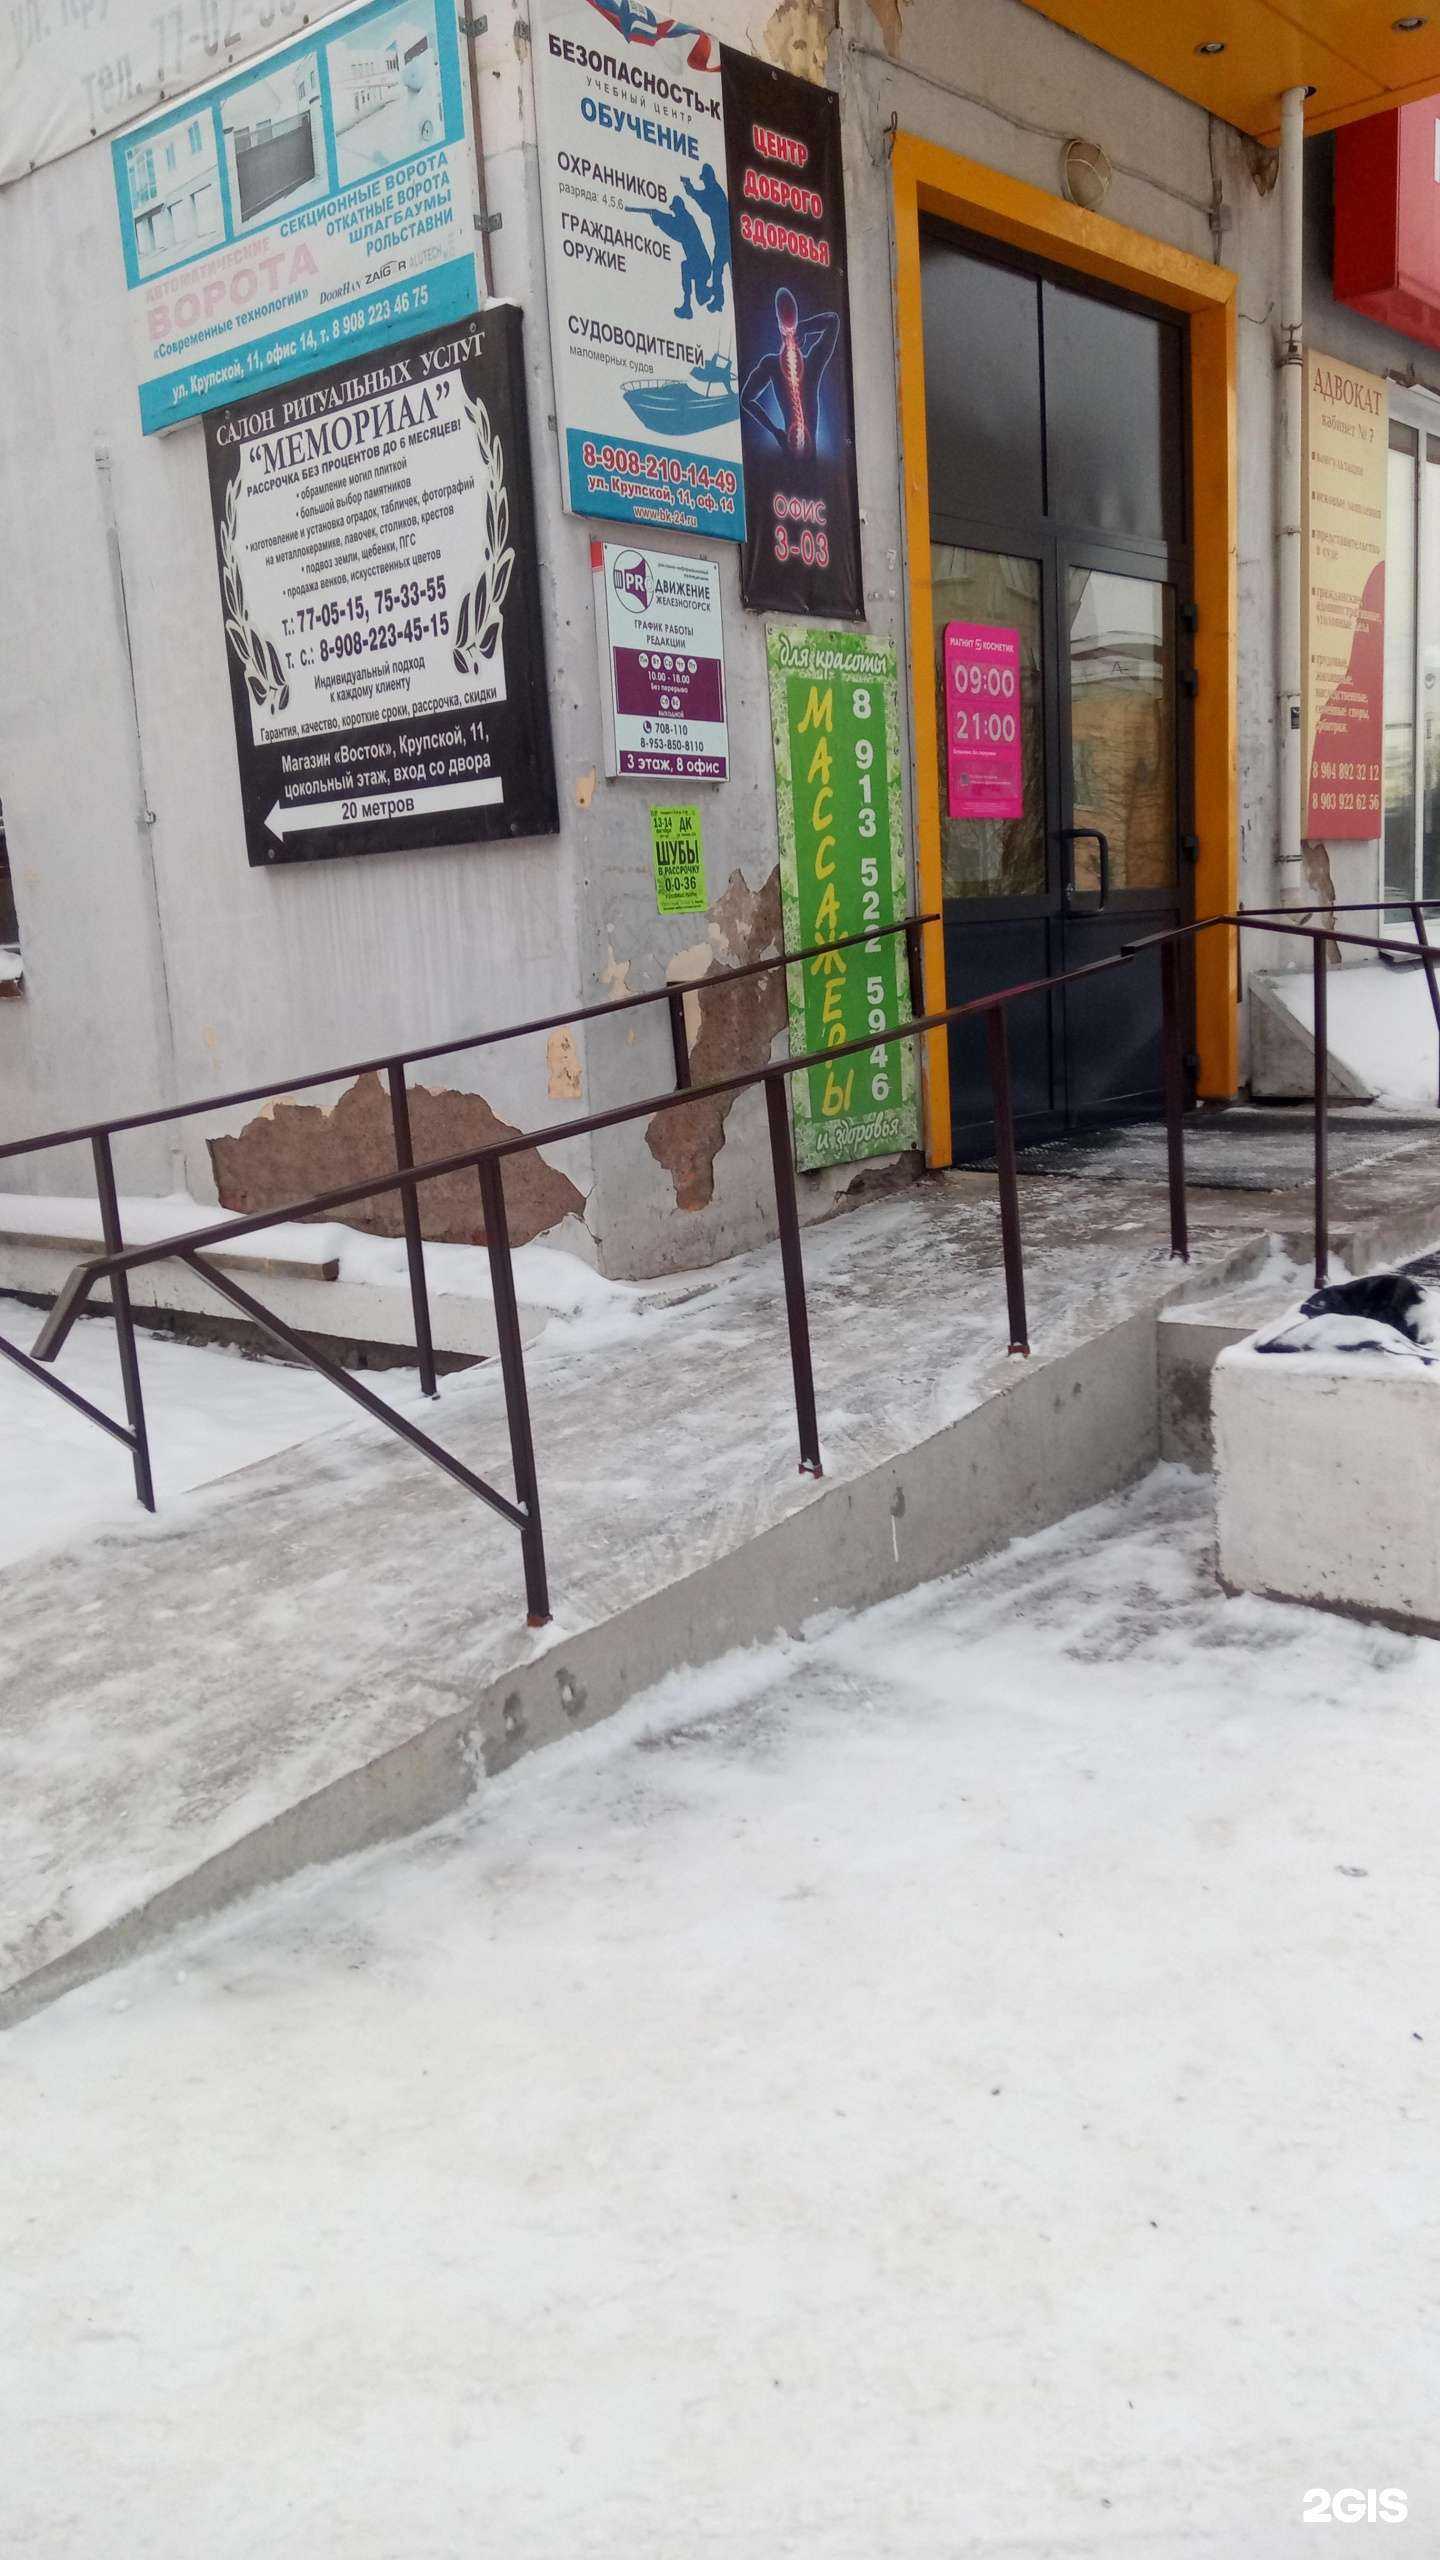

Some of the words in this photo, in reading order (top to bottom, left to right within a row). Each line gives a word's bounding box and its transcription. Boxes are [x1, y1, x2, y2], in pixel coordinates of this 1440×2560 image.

[548, 33, 721, 121] БЕЗОПАСНОСТЬ-К
[586, 75, 647, 108] УЧЕБНЫЙ
[654, 102, 693, 124] ЦЕНТР
[580, 96, 699, 161] ОБУЧЕНИЕ
[753, 125, 808, 167] ЦЕНТР
[280, 180, 381, 238] СЕКЦИОННЫЕ
[385, 151, 448, 192] ВОРОТА
[557, 151, 667, 203] ОХРАННИКОВ
[744, 169, 823, 218] ДОБРОГО
[326, 195, 394, 236] ОТКАТНЫЕ
[398, 171, 450, 205] ВОРОТА
[349, 189, 452, 244] ШЛАГБАУМЫ
[366, 207, 453, 257] РОЛЬСТАВНИ
[561, 212, 671, 261] ГРАЖДАНСКОЕ
[563, 239, 627, 273] ОРУЖИЕ
[741, 215, 830, 266] ЗДОРОВЬЯ
[148, 243, 319, 341] ВОРОТА
[153, 319, 233, 360] «Современные
[236, 288, 309, 327] технологии»
[173, 385, 188, 405] ул.
[191, 359, 244, 395] Крупской,
[247, 350, 263, 371] 11,
[266, 342, 297, 368] офис
[300, 330, 317, 351] 14,
[333, 319, 340, 339] 8
[343, 310, 365, 334] 908
[368, 300, 391, 324] 223
[394, 292, 410, 316] 46
[411, 285, 428, 306] 75
[568, 315, 705, 367] СУДОВОДИТЕЛЕЙ
[569, 345, 627, 367] маломерных
[629, 358, 654, 374] судов
[216, 407, 274, 447] САЛОН
[283, 360, 412, 424] РИТУАЛЬНЫХ
[420, 332, 485, 376] УСЛУГ
[1313, 368, 1382, 416] АДВОКАТ
[247, 472, 299, 497] РАССРОЧКА
[302, 467, 319, 481] БЕЗ
[322, 445, 380, 474] ПРОЦЕНТОВ
[383, 441, 397, 457] ДО
[400, 439, 406, 449] 6
[409, 419, 461, 447] МЕСЯЦЕВ!
[301, 477, 347, 500] обрамление
[349, 469, 372, 485] могил
[374, 458, 407, 478] плиткой
[583, 441, 736, 494] 8-908-210-14-49
[250, 528, 299, 552] изготовление
[306, 519, 345, 538] установка
[346, 508, 379, 527] оградок,
[381, 496, 420, 515] табличек,
[422, 475, 475, 505] фотографий
[300, 497, 334, 519] большой
[336, 493, 362, 510] выбор
[364, 478, 411, 501] памятников
[589, 474, 609, 491] ул.
[611, 479, 675, 503] Крупской,
[677, 489, 694, 507] 11,
[697, 495, 719, 512] оф.
[721, 497, 734, 512] 14
[633, 506, 698, 528] www.bk-24.ru
[773, 494, 827, 526] ОФИС
[265, 556, 275, 567] на
[275, 538, 343, 565] металлокерамике,
[344, 529, 378, 548] лавочек,
[379, 516, 420, 536] столиков,
[421, 505, 454, 525] крестов
[306, 559, 333, 574] подвоз
[334, 551, 360, 568] земли,
[362, 542, 398, 561] щебенки,
[399, 533, 416, 551] ПГС
[774, 526, 829, 567] 3-03
[286, 581, 319, 599] продажа
[320, 573, 349, 591] венков,
[350, 555, 411, 582] искусственных
[412, 549, 441, 568] цветов
[655, 578, 710, 600] ДВИЖЕНИЕ
[296, 595, 370, 633] 77-05-15,
[374, 574, 447, 615] 75-33-55
[656, 595, 711, 612] ЖЕЛЕЗНОГОРСК
[319, 611, 450, 662] 8-908-223-45-15
[634, 619, 663, 632] ГРАФИК
[665, 624, 694, 637] РАБОТЫ
[647, 634, 686, 649] РЕДАКЦИИ
[314, 660, 390, 690] Индивидуальный
[392, 656, 425, 680] подход
[779, 633, 809, 669] для
[814, 646, 888, 680] красоты
[336, 684, 373, 705] каждому
[375, 675, 411, 699] клиенту
[852, 688, 872, 720] 8
[954, 664, 1015, 698] 09:00
[260, 725, 299, 742] Гарантия,
[300, 717, 340, 736] качество,
[341, 710, 380, 731] короткие
[381, 705, 410, 724] сроки,
[412, 696, 462, 718] рассрочка,
[464, 687, 497, 706] скидки
[655, 723, 688, 736] 708-110
[955, 710, 1016, 742] 21:00
[282, 750, 331, 773] Магазин
[334, 741, 396, 767] «Восток»,
[399, 726, 467, 755] Крупской,
[470, 721, 489, 745] 11,
[627, 753, 635, 769] 3
[638, 758, 673, 773] этаж,
[676, 757, 683, 772] 8
[686, 758, 720, 776] офис
[640, 738, 704, 752] 8-953-850-8110
[285, 768, 354, 801] цокольный
[357, 770, 390, 788] этаж,
[394, 763, 426, 783] вход
[429, 760, 445, 777] со
[449, 752, 491, 775] двора
[341, 801, 358, 820] 20
[361, 796, 415, 819] метров
[656, 840, 700, 866] ШУБЫ
[816, 1129, 830, 1152] и
[834, 1112, 900, 1154] здоровья
